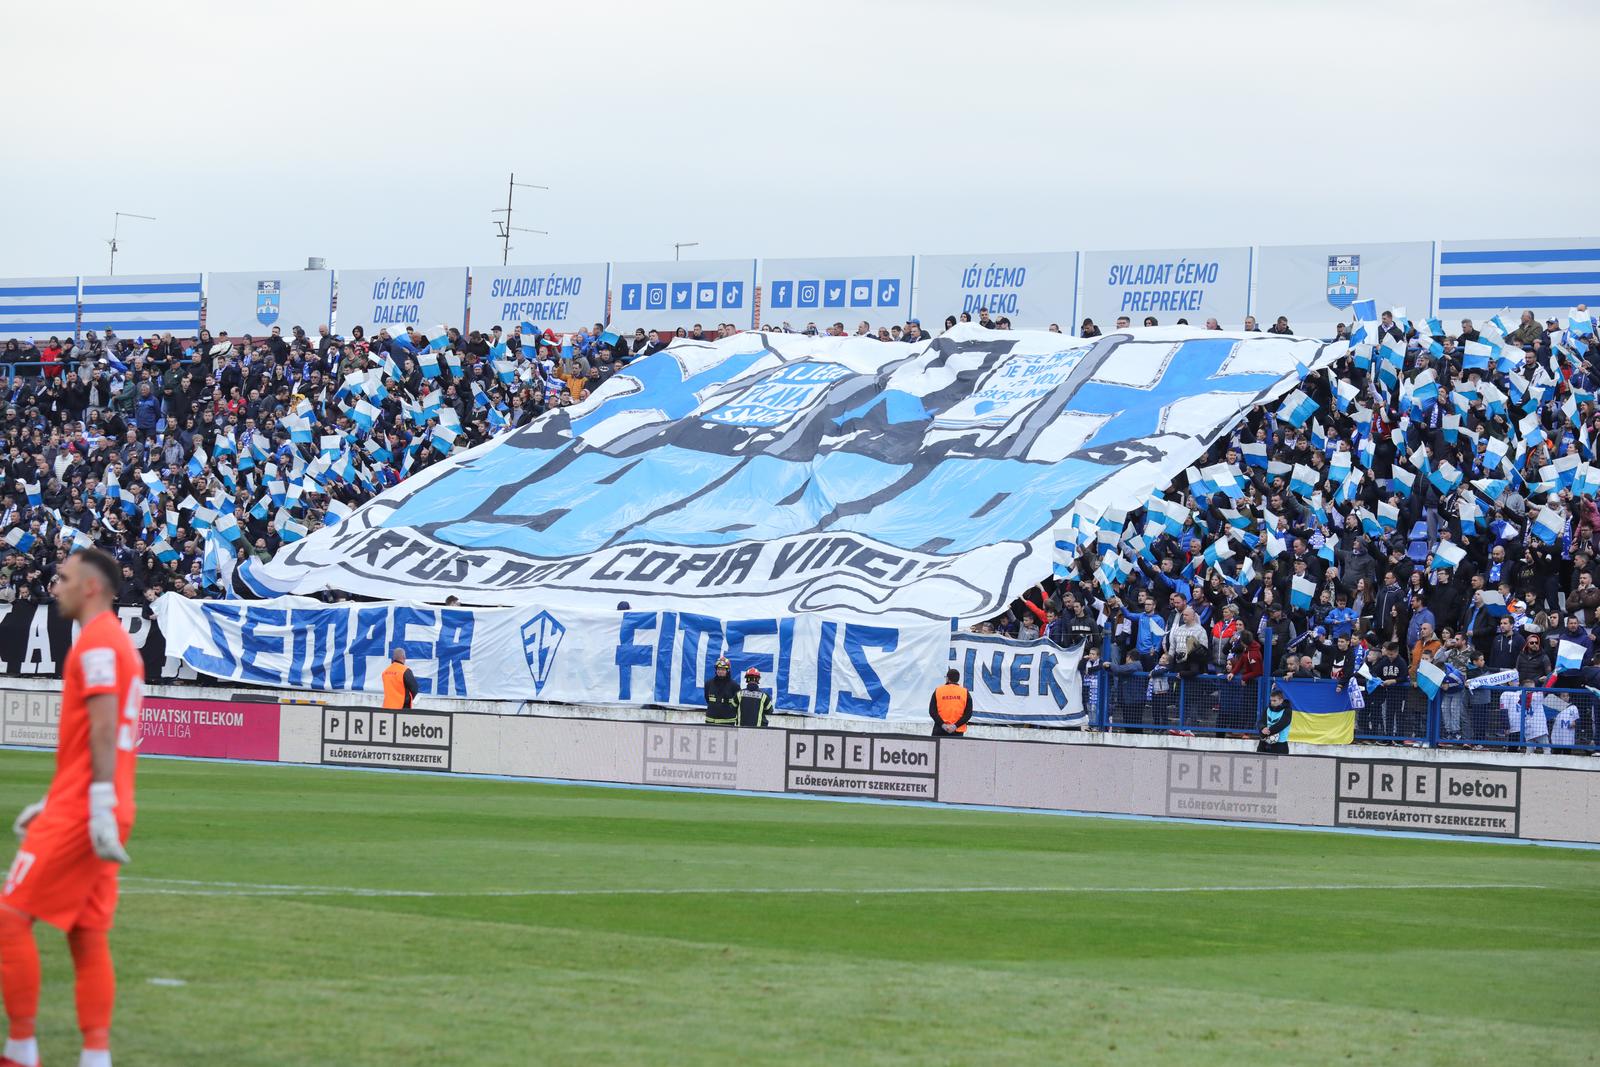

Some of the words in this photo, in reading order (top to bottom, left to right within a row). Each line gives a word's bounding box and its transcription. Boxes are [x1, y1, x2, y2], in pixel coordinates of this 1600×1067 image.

[961, 262, 983, 289] IĆI
[984, 262, 1026, 288] ĆEMO
[1108, 263, 1173, 286] SVLADAT
[1174, 257, 1219, 284] ĆEMO
[372, 276, 390, 300] IĆI
[391, 276, 425, 300] ĆEMO
[491, 278, 545, 298] SVLADAT
[545, 272, 582, 297] ĆEMO
[963, 293, 1020, 317] DALEKO,
[1121, 290, 1204, 312] PREPREKE!
[373, 304, 420, 326] DALEKO,
[590, 543, 765, 588] COPIA
[183, 602, 475, 697] SEMPER
[615, 611, 899, 719] FIDELIS
[139, 703, 191, 725] HRVATSKI
[193, 710, 244, 727] TELEKOM
[137, 722, 165, 737] PRVA
[167, 723, 192, 739] LIGA
[402, 721, 443, 739] beton
[392, 752, 442, 764] SZERKEZETEK
[880, 746, 928, 766] beton
[795, 774, 867, 789] ELŐREGYÁRTOTT
[868, 781, 927, 793] SZERKEZETEK
[1449, 777, 1508, 799] beton
[1347, 807, 1433, 824] ELŐREGYÁRTOTT
[1434, 814, 1507, 828] SZERKEZETEK
